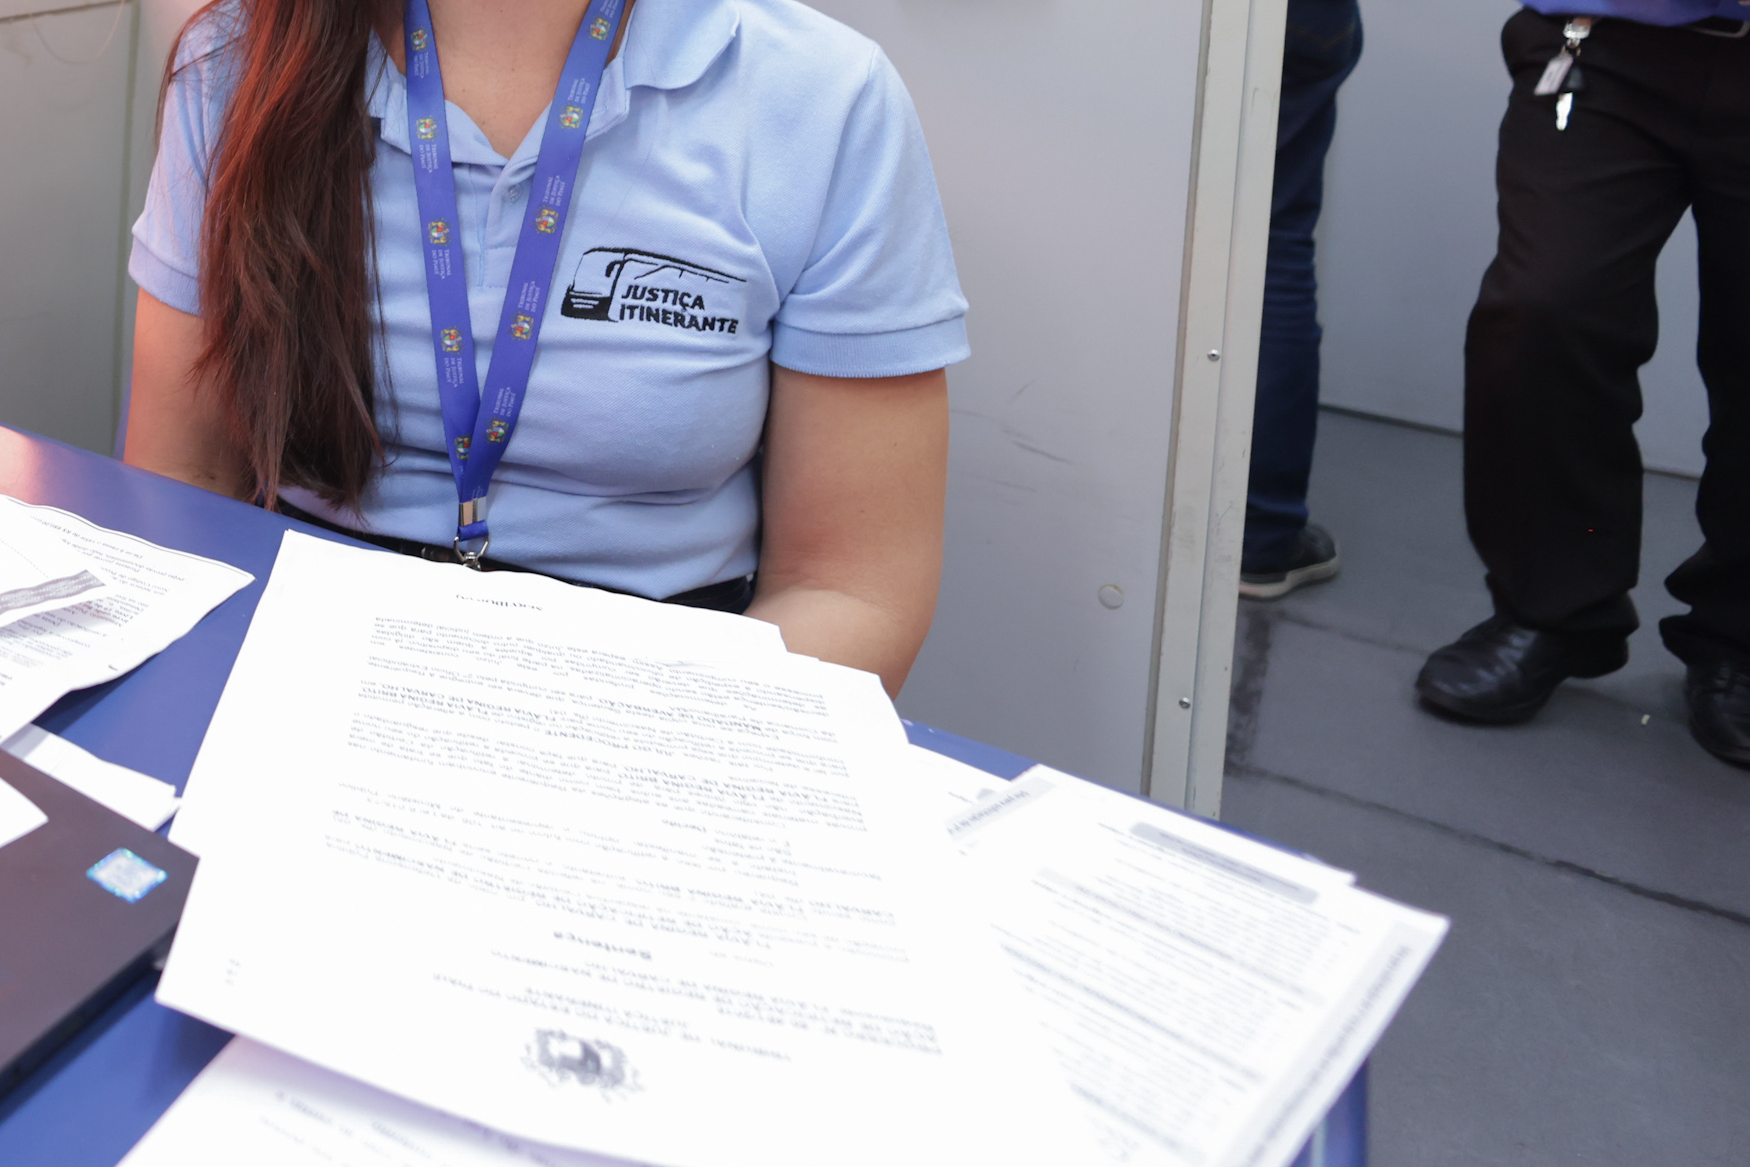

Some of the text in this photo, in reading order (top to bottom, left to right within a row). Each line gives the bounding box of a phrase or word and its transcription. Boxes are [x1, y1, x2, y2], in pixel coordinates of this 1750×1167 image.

[622, 285, 705, 311] JUSTIÇA
[619, 304, 739, 334] ITINERANTE
[696, 714, 761, 732] MANDADO
[552, 929, 652, 962] Sentença
